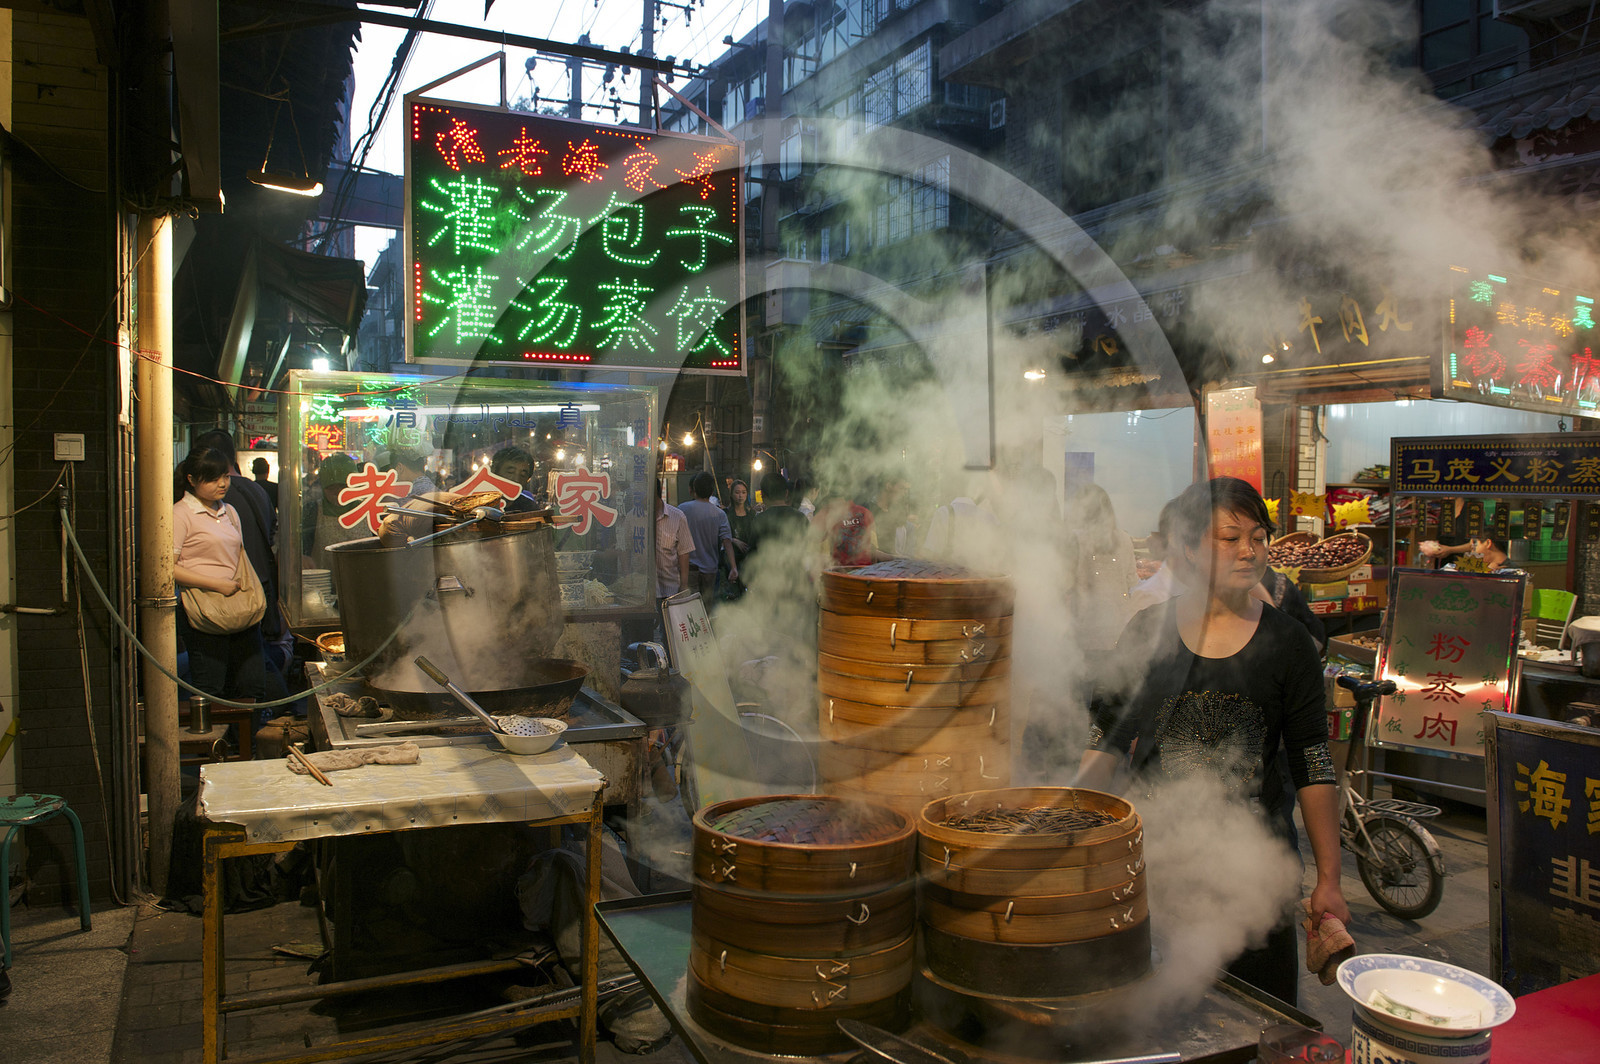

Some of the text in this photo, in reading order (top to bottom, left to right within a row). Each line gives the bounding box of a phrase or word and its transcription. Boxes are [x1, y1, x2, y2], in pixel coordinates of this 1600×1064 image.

[421, 174, 733, 270] 灌汤包子
[422, 264, 731, 356] 灌汤蒸饺
[385, 398, 418, 428] 清
[555, 401, 585, 430] 真
[1414, 632, 1471, 747] 粉蒸肉
